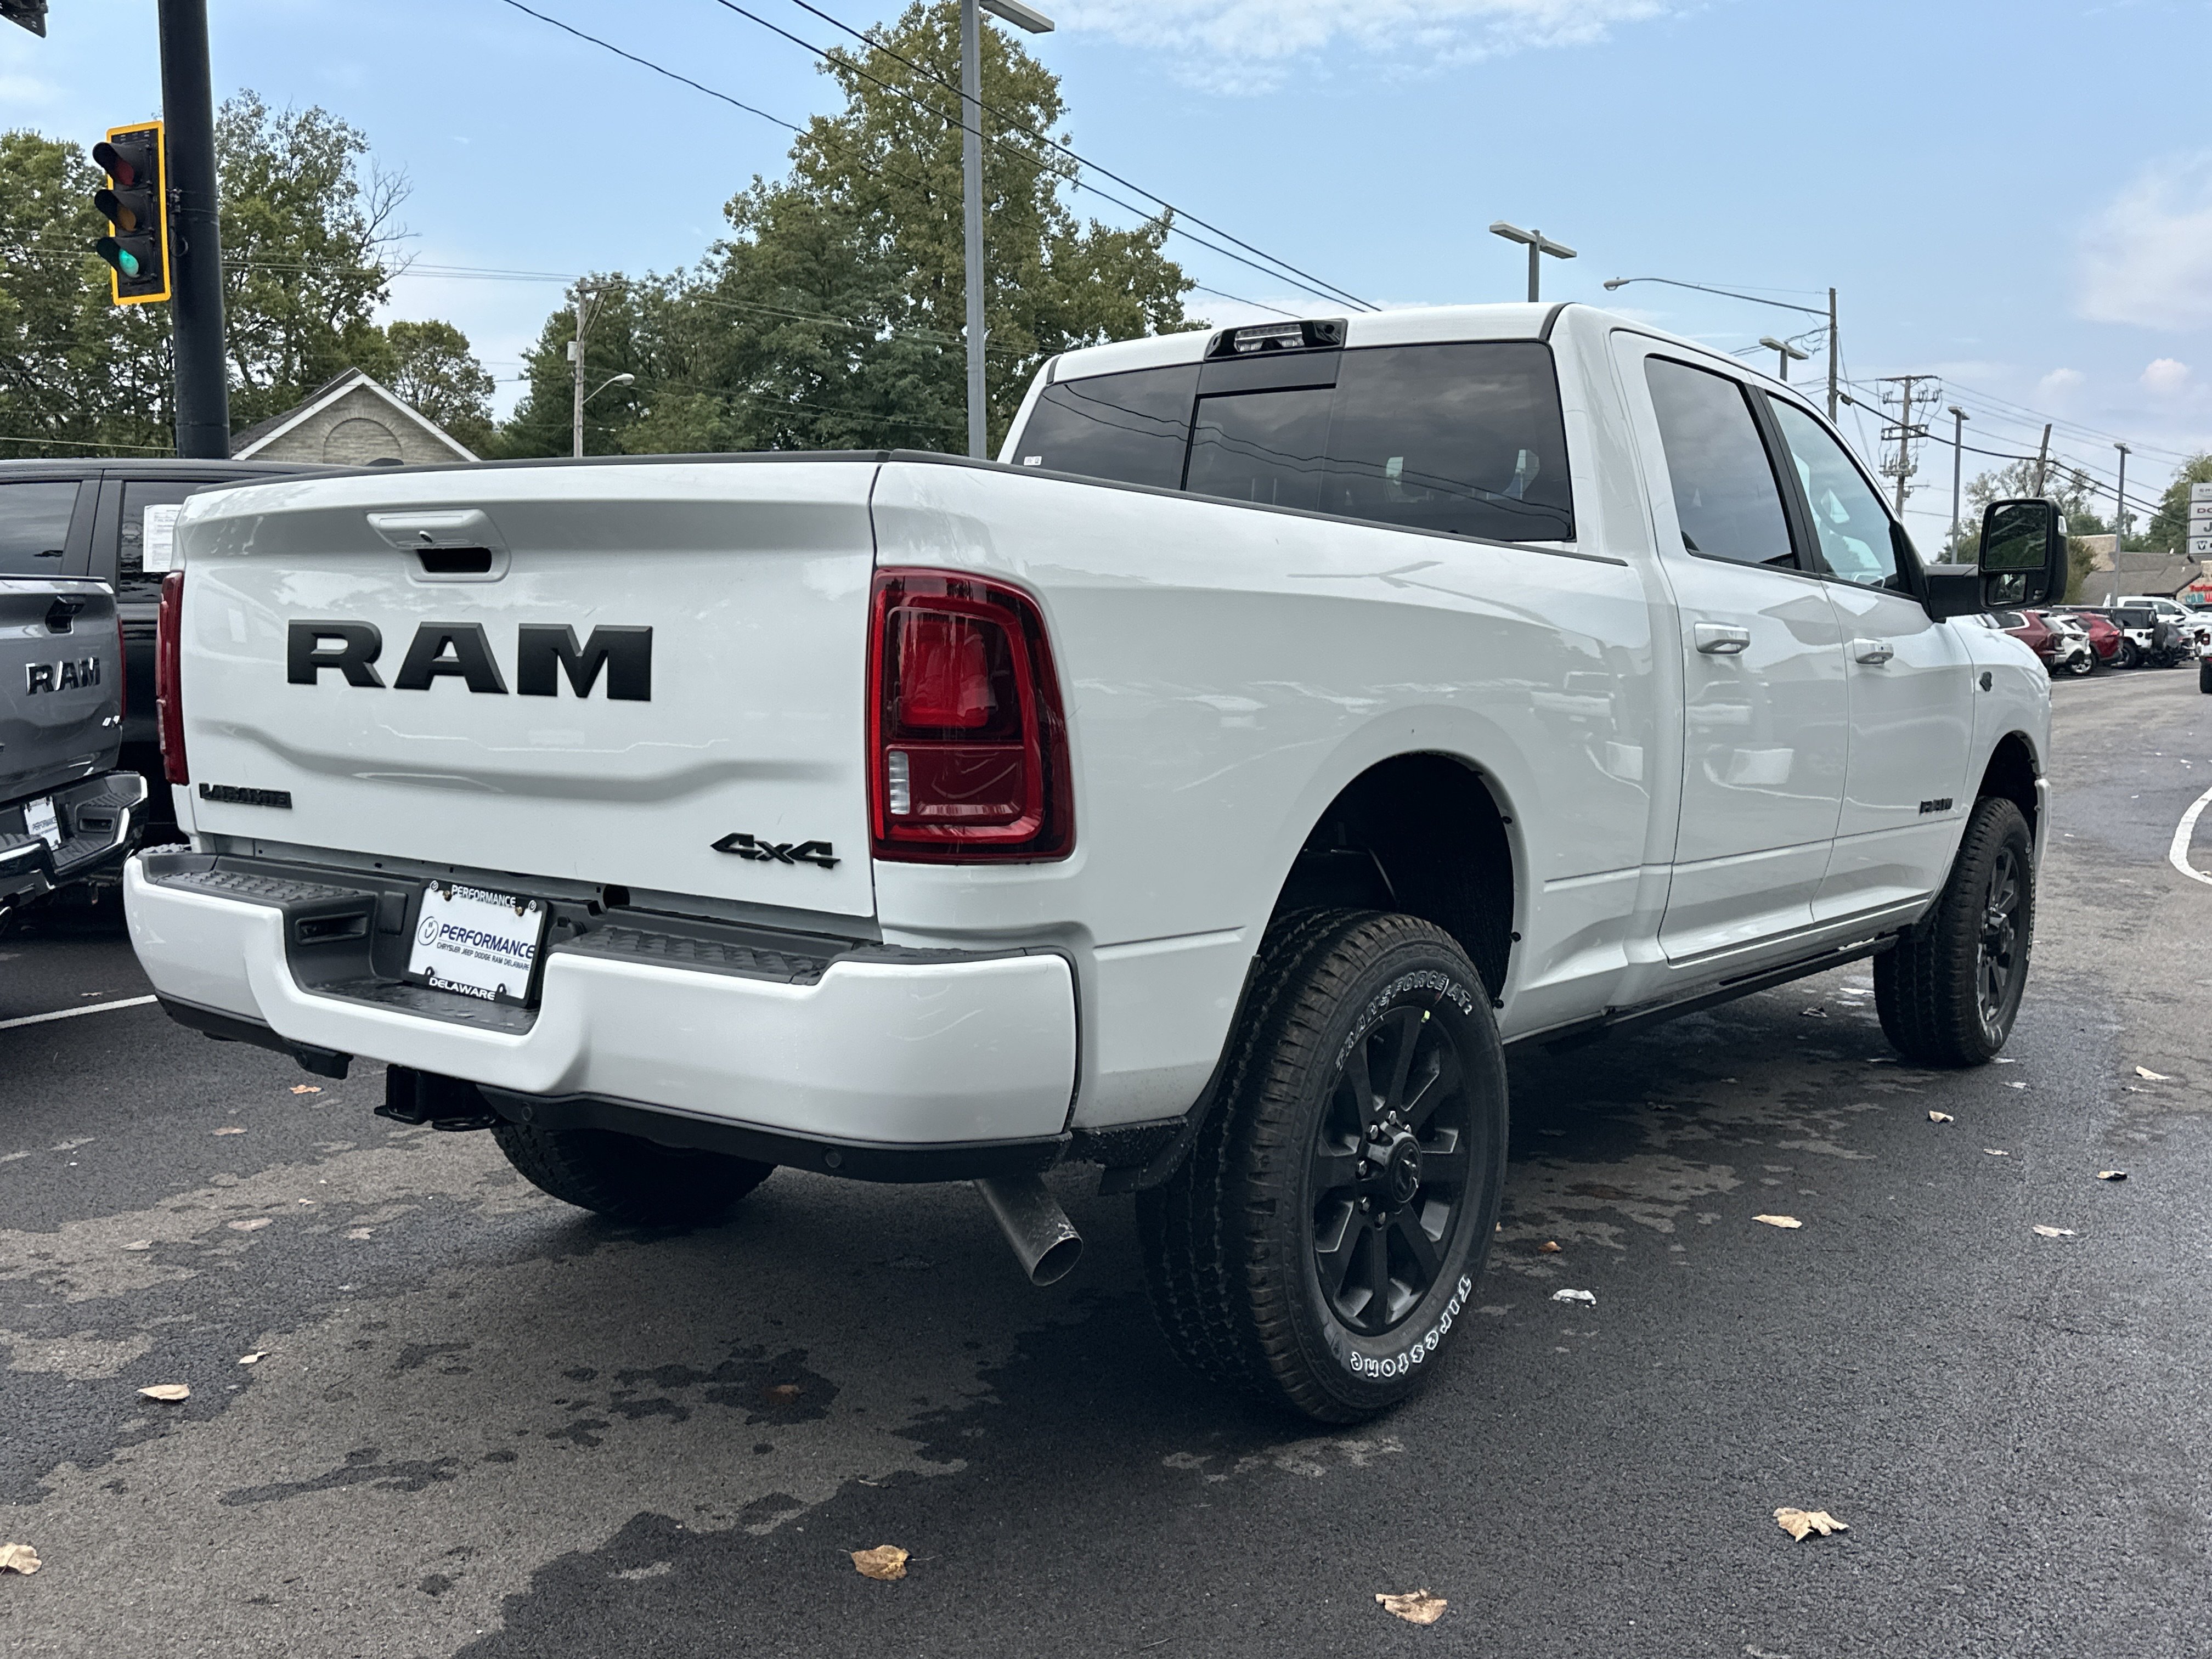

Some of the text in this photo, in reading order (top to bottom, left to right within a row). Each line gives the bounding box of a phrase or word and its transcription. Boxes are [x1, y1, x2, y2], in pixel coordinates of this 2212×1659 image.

[25, 657, 101, 696] RAM
[287, 619, 653, 702] RAM
[451, 884, 516, 908] PERFORMANCE
[437, 941, 531, 970] CHRYSLER JEEP DODGE RAM DELAWARE
[439, 923, 536, 959] PERFORMANCE
[428, 977, 495, 1001] DELAWARE
